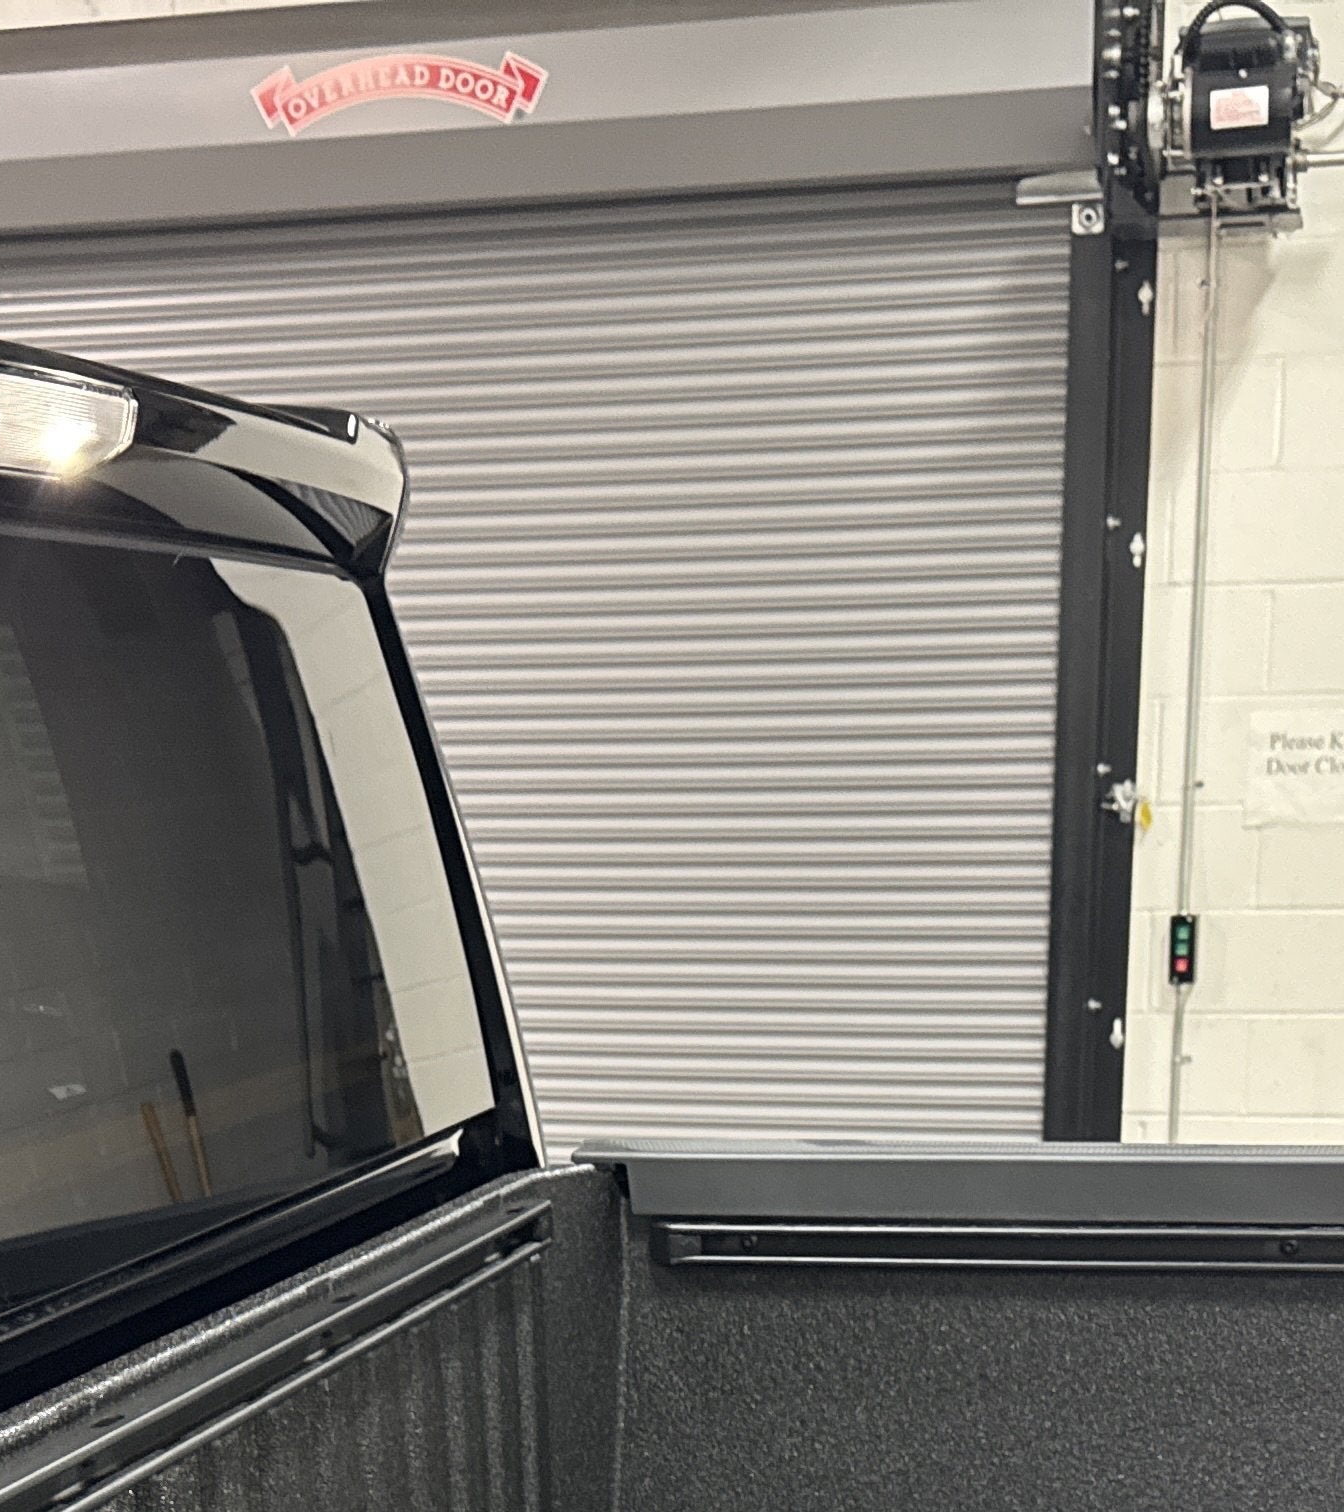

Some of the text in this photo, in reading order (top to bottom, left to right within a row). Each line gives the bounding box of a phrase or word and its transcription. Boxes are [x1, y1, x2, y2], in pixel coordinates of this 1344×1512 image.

[287, 64, 510, 120] OVERHEAD DOOR
[1269, 731, 1325, 751] Please
[1265, 756, 1309, 776] Door
